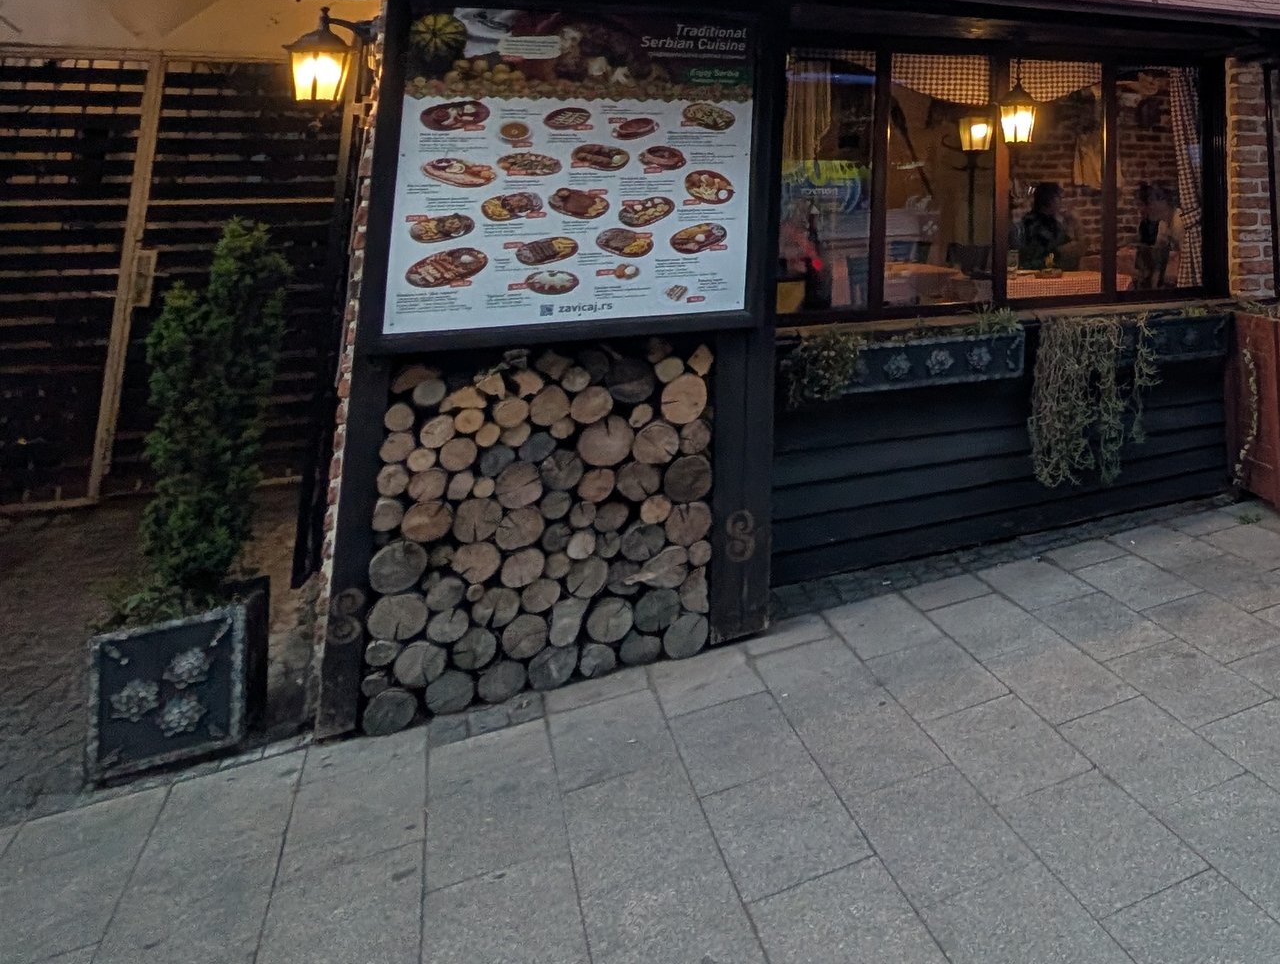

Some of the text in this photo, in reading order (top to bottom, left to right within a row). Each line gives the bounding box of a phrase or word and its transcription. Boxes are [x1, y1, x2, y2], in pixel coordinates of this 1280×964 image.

[676, 23, 747, 38] Traditional
[640, 36, 746, 51] Serbian Cuisine
[558, 301, 613, 315] zavicaj.rs
